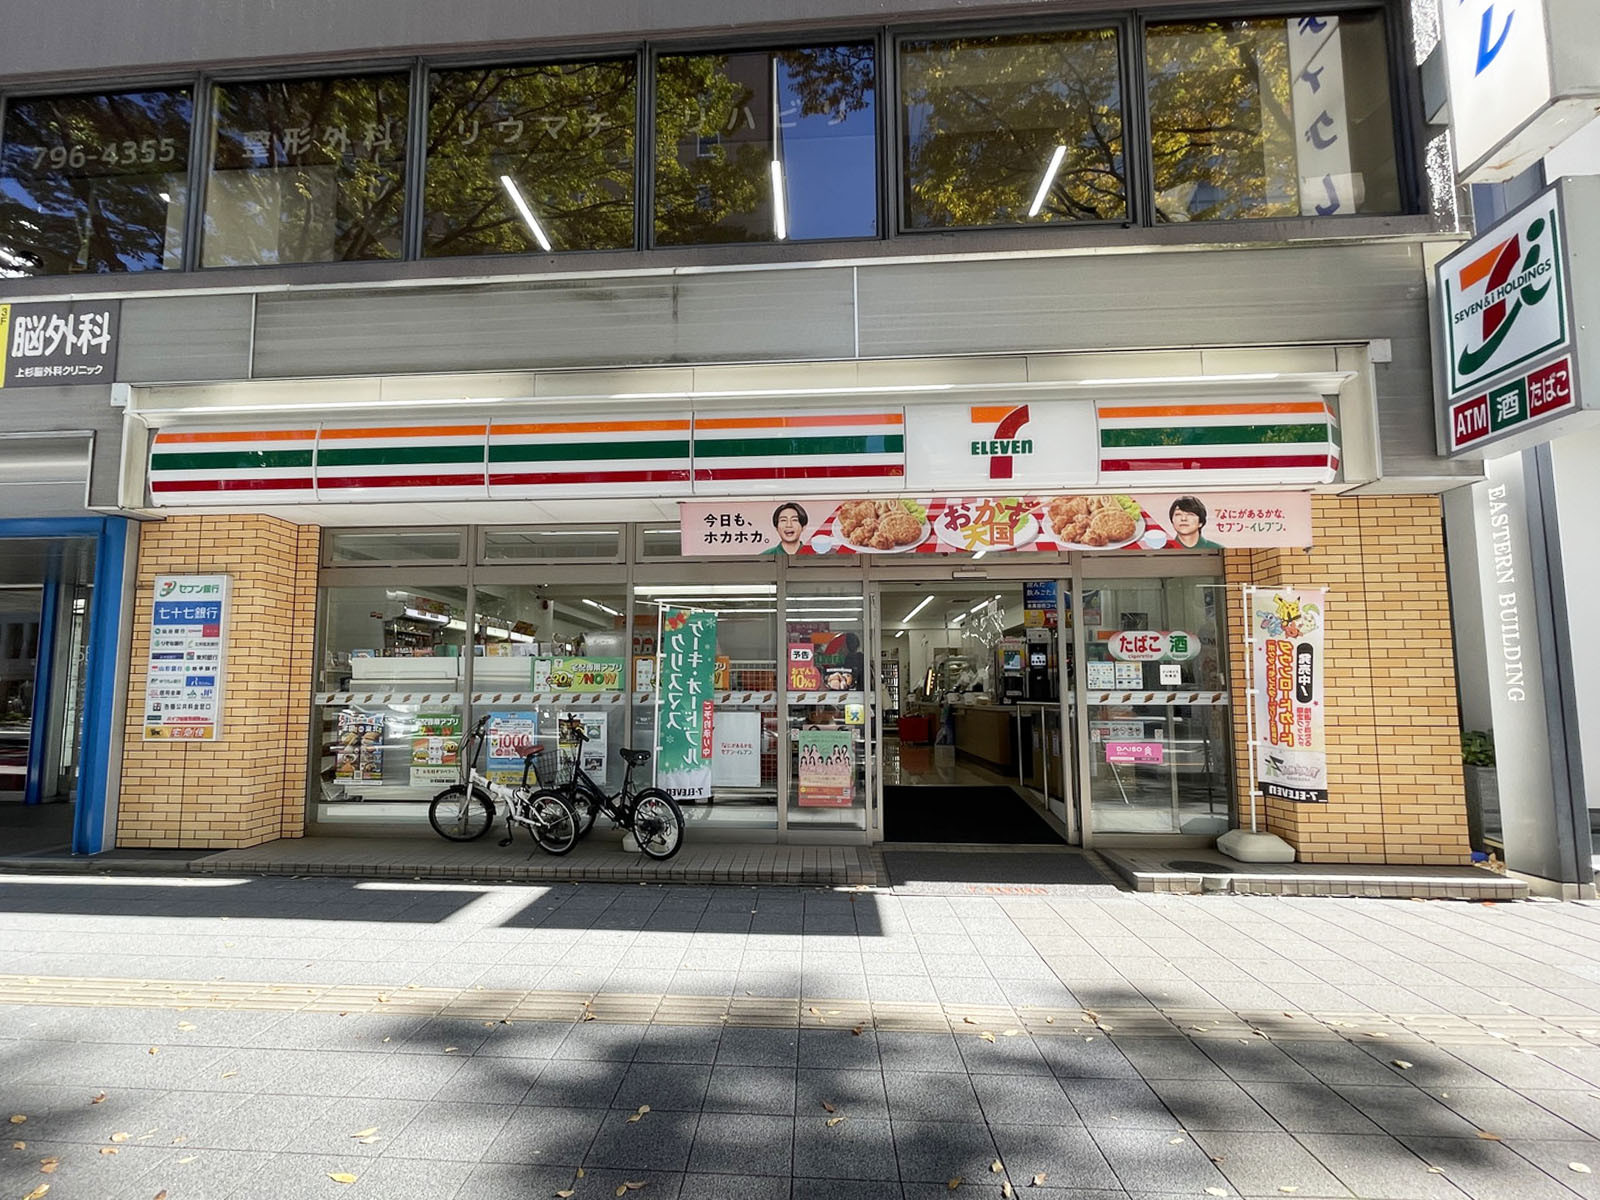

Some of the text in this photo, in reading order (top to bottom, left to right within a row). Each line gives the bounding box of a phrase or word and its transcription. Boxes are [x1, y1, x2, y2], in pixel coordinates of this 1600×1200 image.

[242, 122, 392, 159] 整形外科
[458, 112, 612, 145] リウマチ
[32, 138, 176, 170] 796-4355
[1497, 258, 1552, 301] HOLDINGS
[11, 311, 111, 358] 脳外科
[15, 364, 104, 378] 上杉脳外科クリニック
[1529, 368, 1569, 410] たばこ
[1496, 388, 1520, 423] 酒
[1456, 402, 1488, 439] ATM
[704, 513, 753, 528] 今日も、
[943, 499, 1040, 532] おかず
[704, 530, 770, 545] ホカホカ。
[960, 523, 1014, 551] 天国
[179, 584, 220, 594] セブン銀行
[1488, 484, 1527, 703] EASTERN BUILDING
[159, 606, 218, 619] 七十七銀行
[792, 650, 809, 659] 予告
[1119, 635, 1162, 653] たばこ
[1169, 635, 1188, 653] 酒
[575, 672, 617, 685] 7NOW
